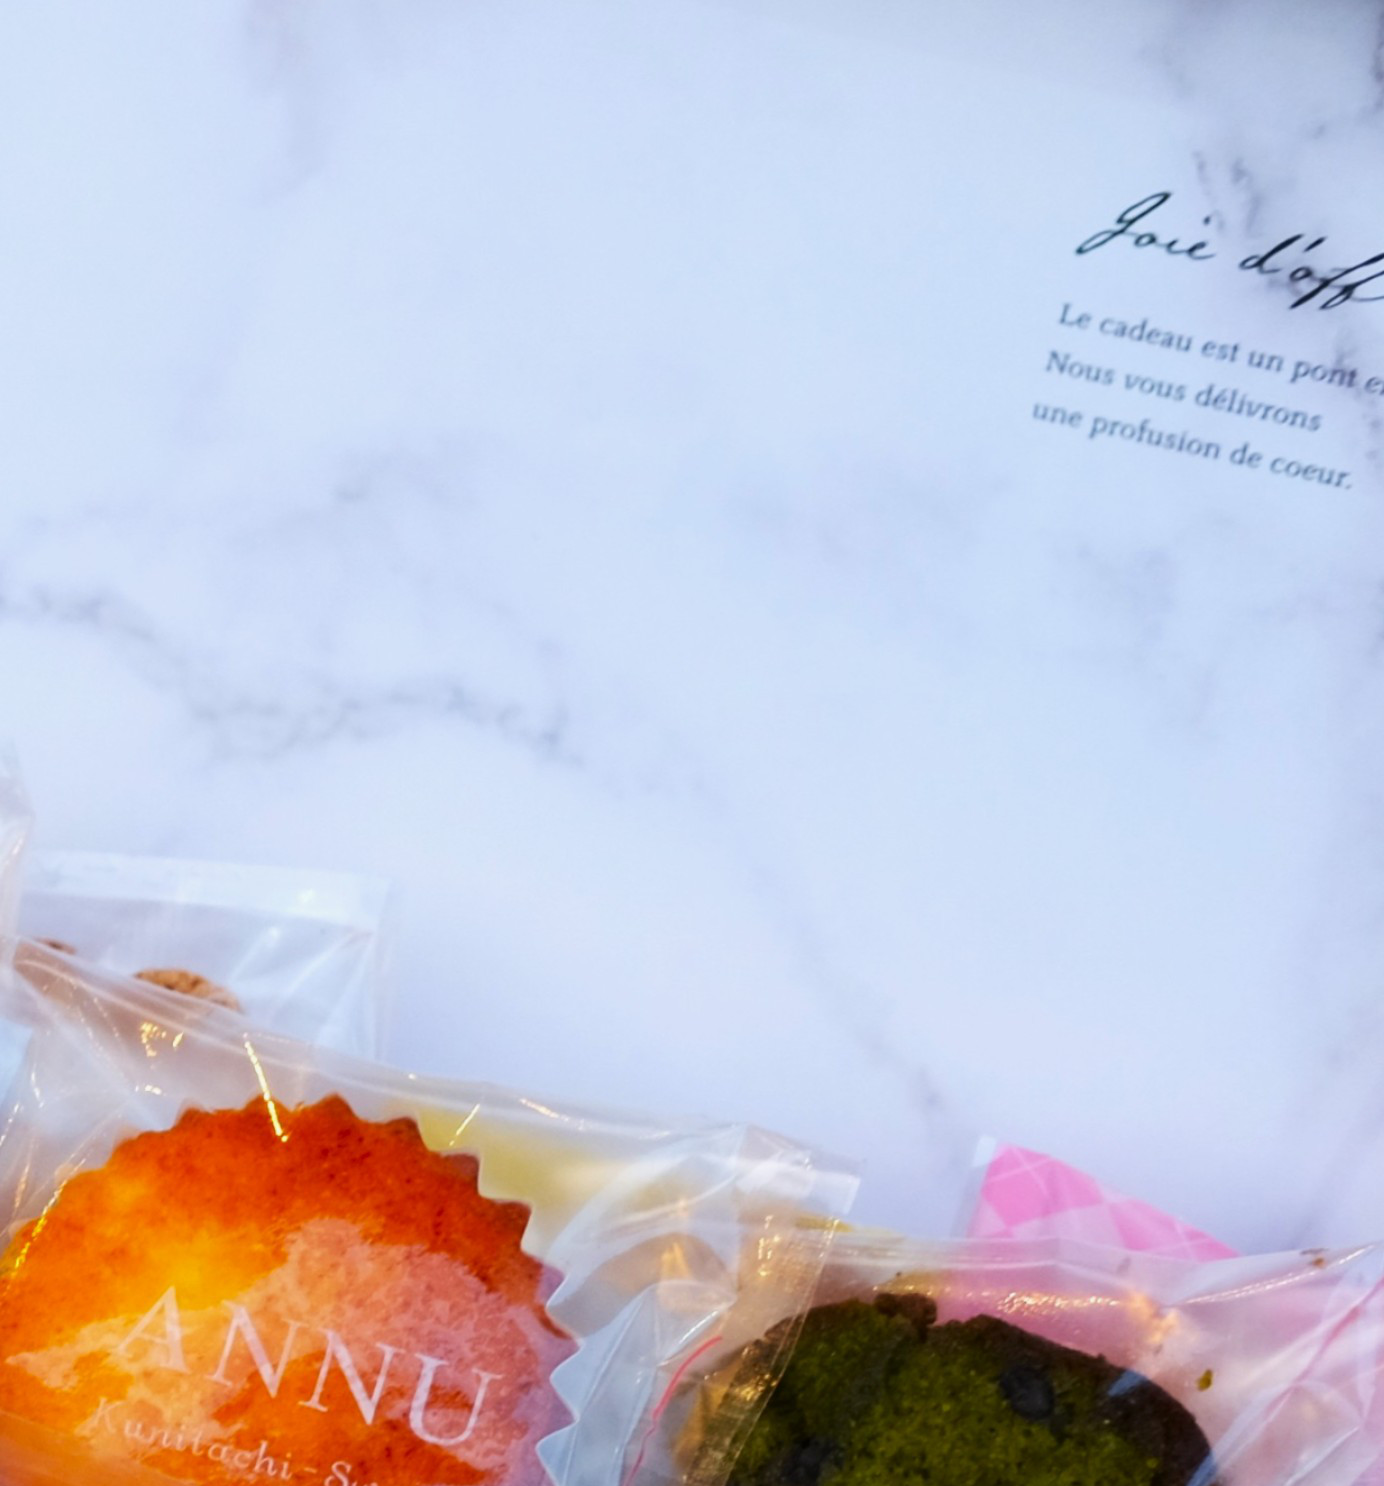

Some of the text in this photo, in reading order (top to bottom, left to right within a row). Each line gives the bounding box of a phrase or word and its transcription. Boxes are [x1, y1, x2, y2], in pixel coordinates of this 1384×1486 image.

[1075, 191, 1216, 259] Joie
[1058, 302, 1090, 330] Le
[1099, 314, 1193, 354] cadeau
[1201, 340, 1241, 364] est
[1247, 349, 1284, 373] un
[1289, 360, 1358, 388] pont
[1044, 350, 1323, 433] Nous vous délivrons
[1032, 402, 1354, 492] une profusion de coeur.
[116, 1285, 504, 1448] ANNU
